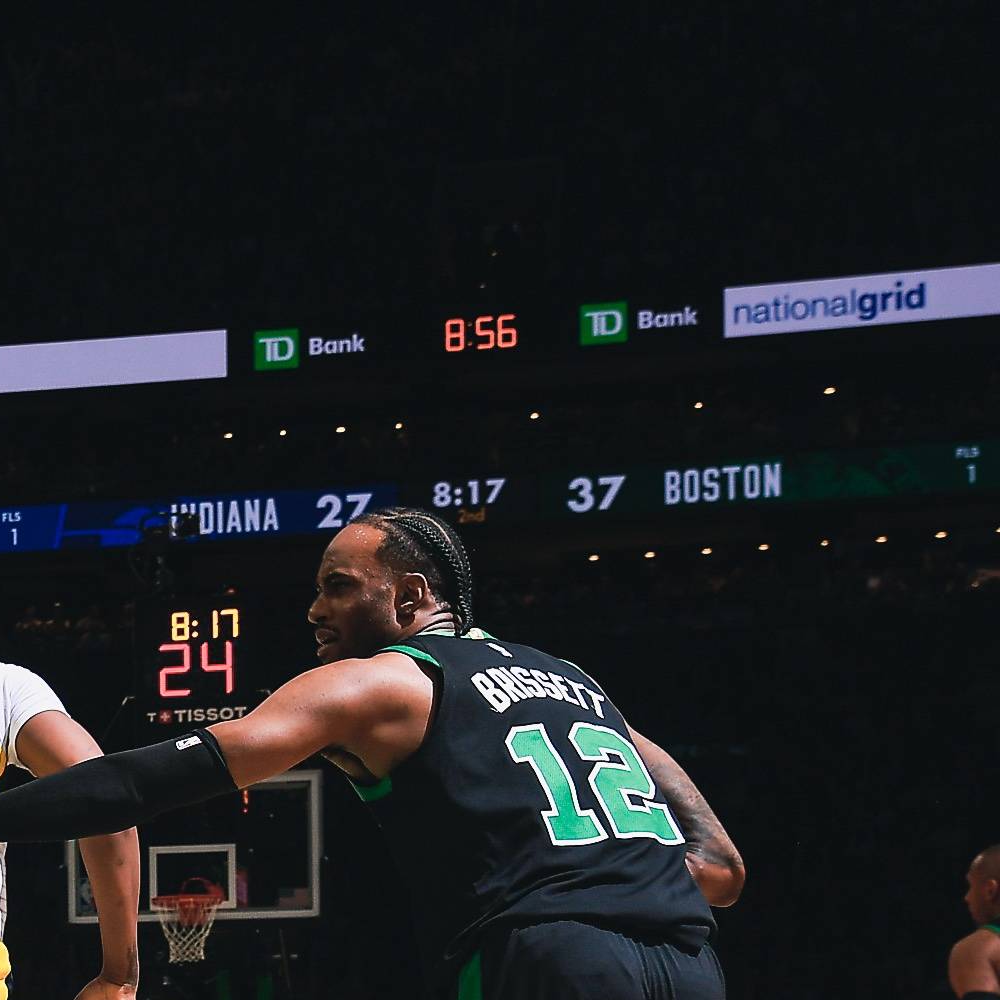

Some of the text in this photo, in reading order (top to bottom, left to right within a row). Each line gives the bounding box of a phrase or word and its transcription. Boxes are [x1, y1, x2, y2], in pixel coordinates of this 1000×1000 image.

[585, 306, 697, 337] TD Bank
[733, 282, 926, 326] nationalgrid
[259, 333, 365, 362] TD Bank
[445, 314, 518, 352] 8:56
[664, 462, 782, 505] BOSTON
[965, 464, 977, 484] 1
[432, 477, 507, 508] 8:17
[567, 475, 626, 513] 37
[1, 511, 22, 523] FLS
[170, 493, 373, 537] IDIANA 27
[10, 527, 19, 546] 1
[171, 608, 240, 642] 8:17
[157, 640, 235, 698] 24
[470, 666, 605, 719] BRISSETT
[174, 706, 247, 723] TISSOT
[504, 721, 686, 846] 12
